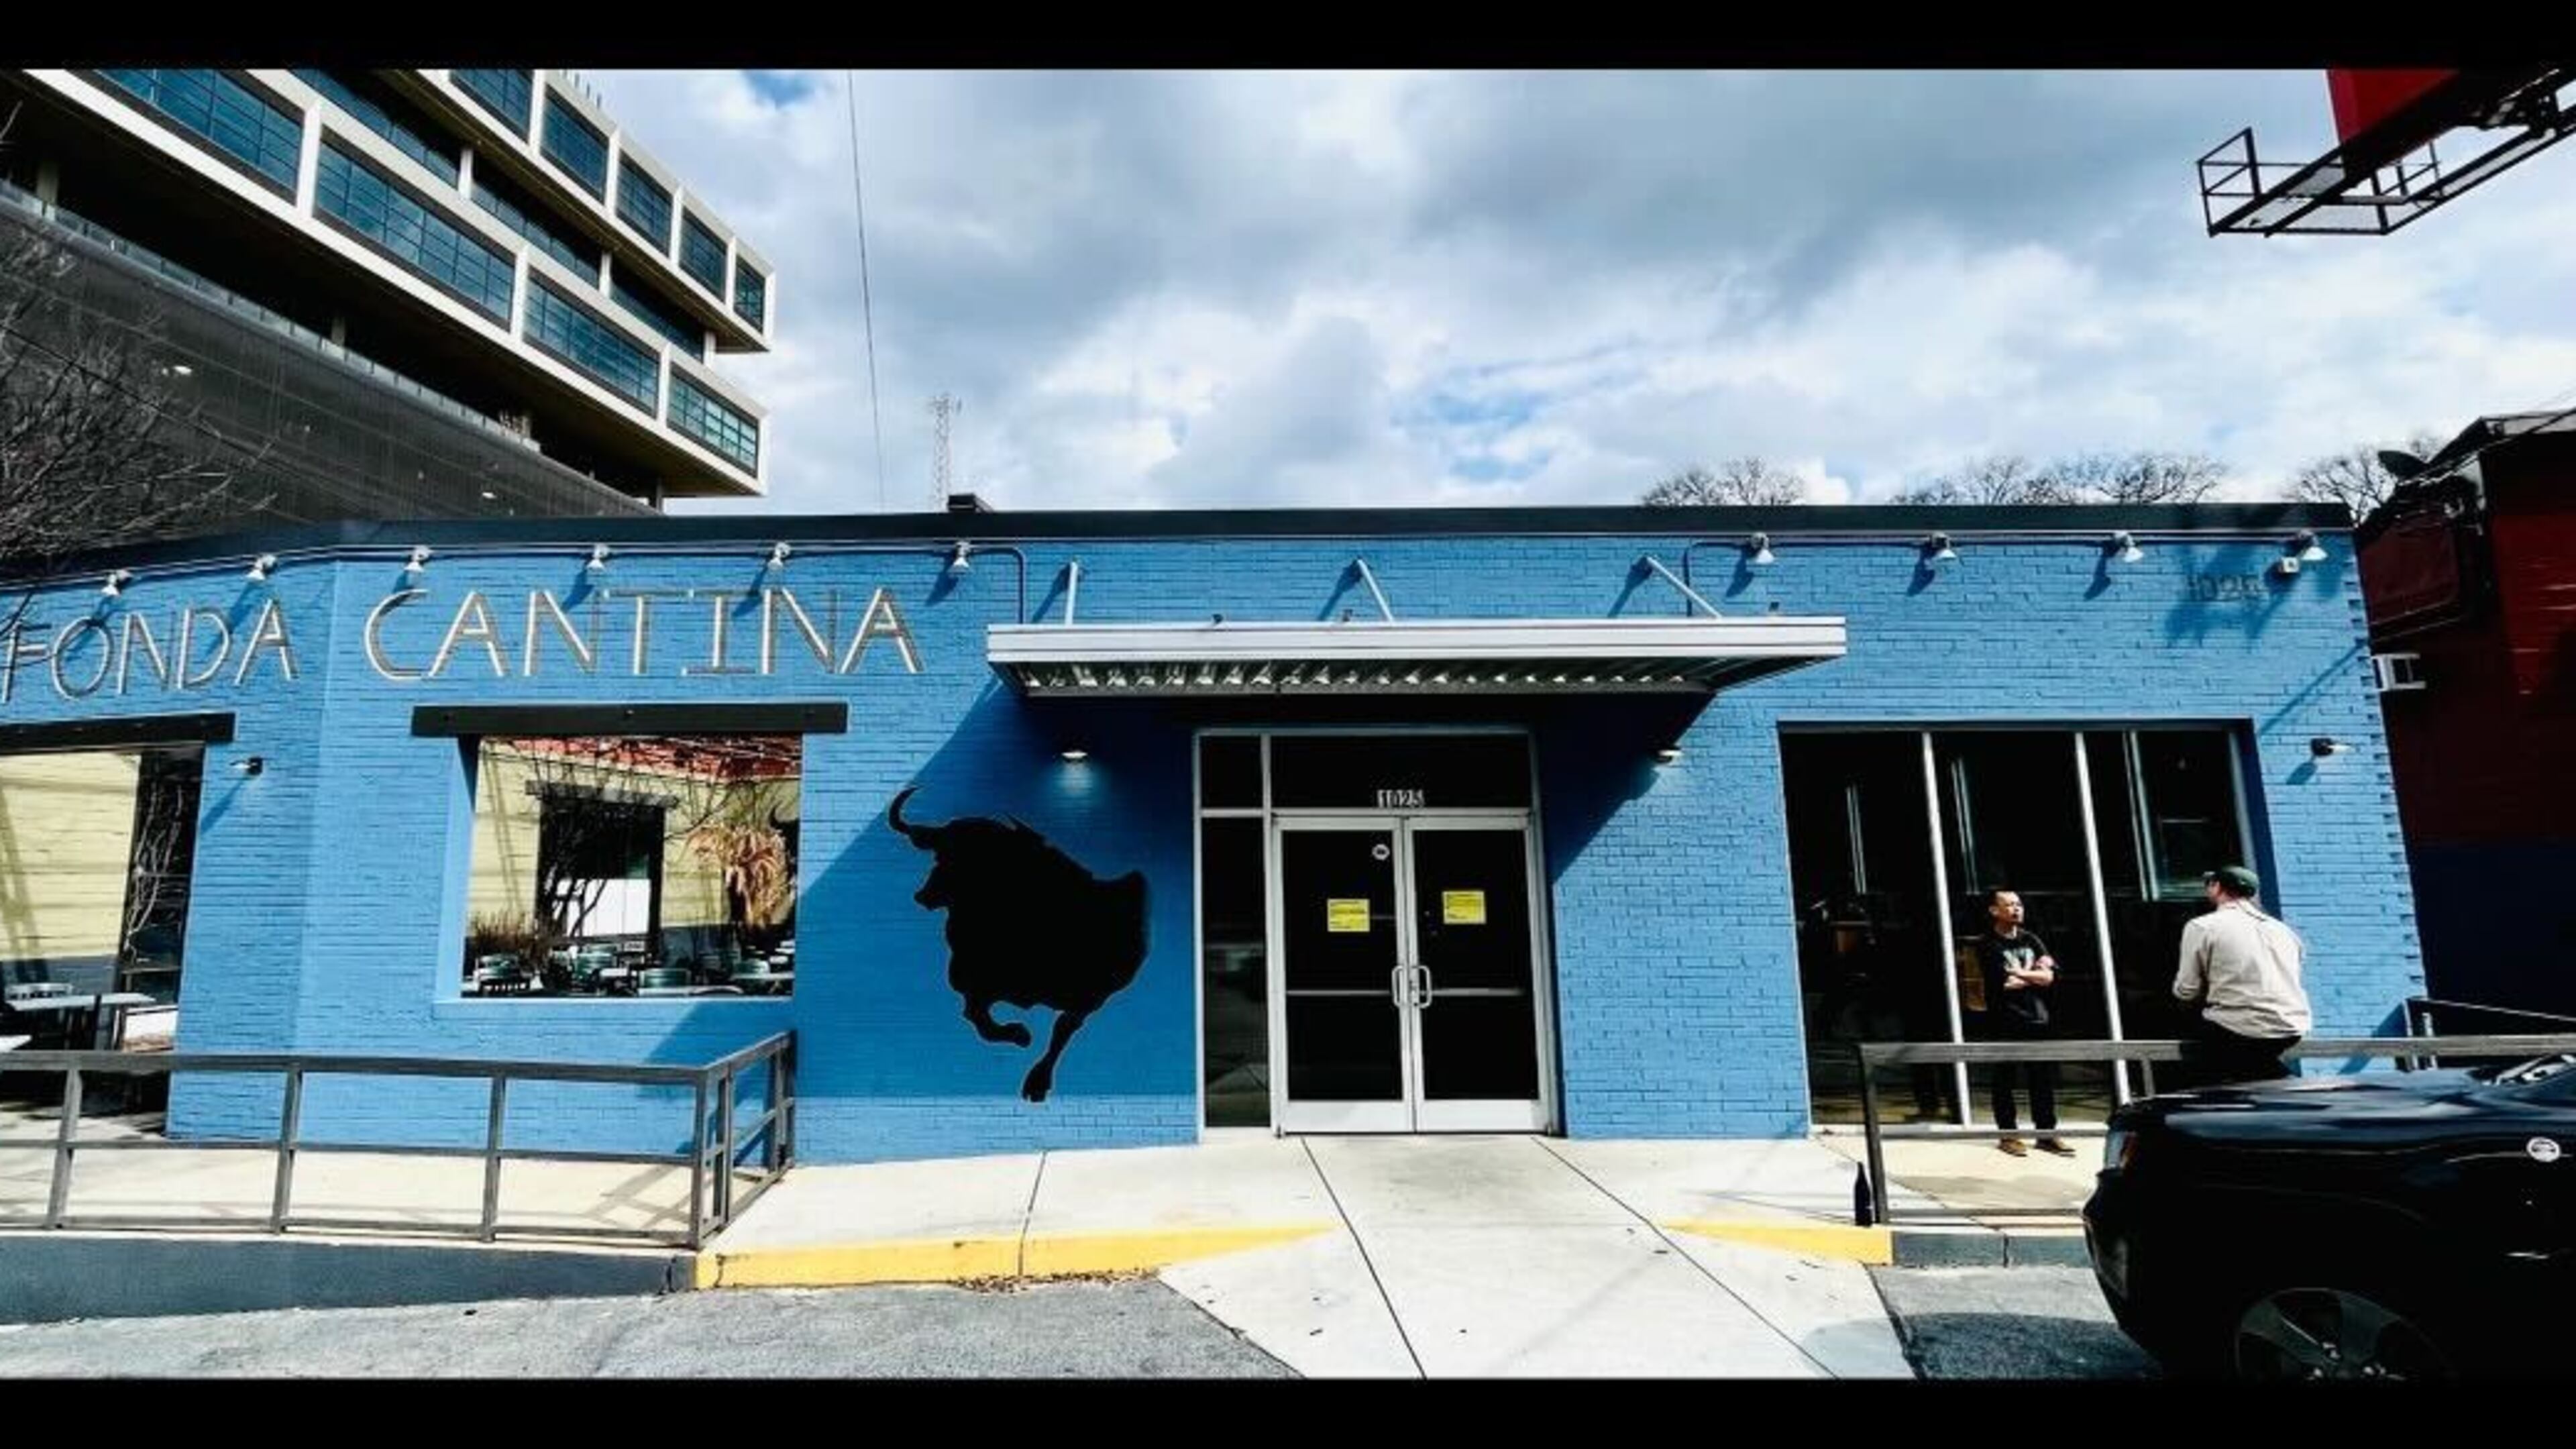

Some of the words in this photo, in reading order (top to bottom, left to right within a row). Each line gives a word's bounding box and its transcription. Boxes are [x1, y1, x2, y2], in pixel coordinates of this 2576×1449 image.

[2, 598, 298, 703] FONDA
[364, 588, 924, 682] CANTINA
[1377, 790, 1425, 809] 1025
